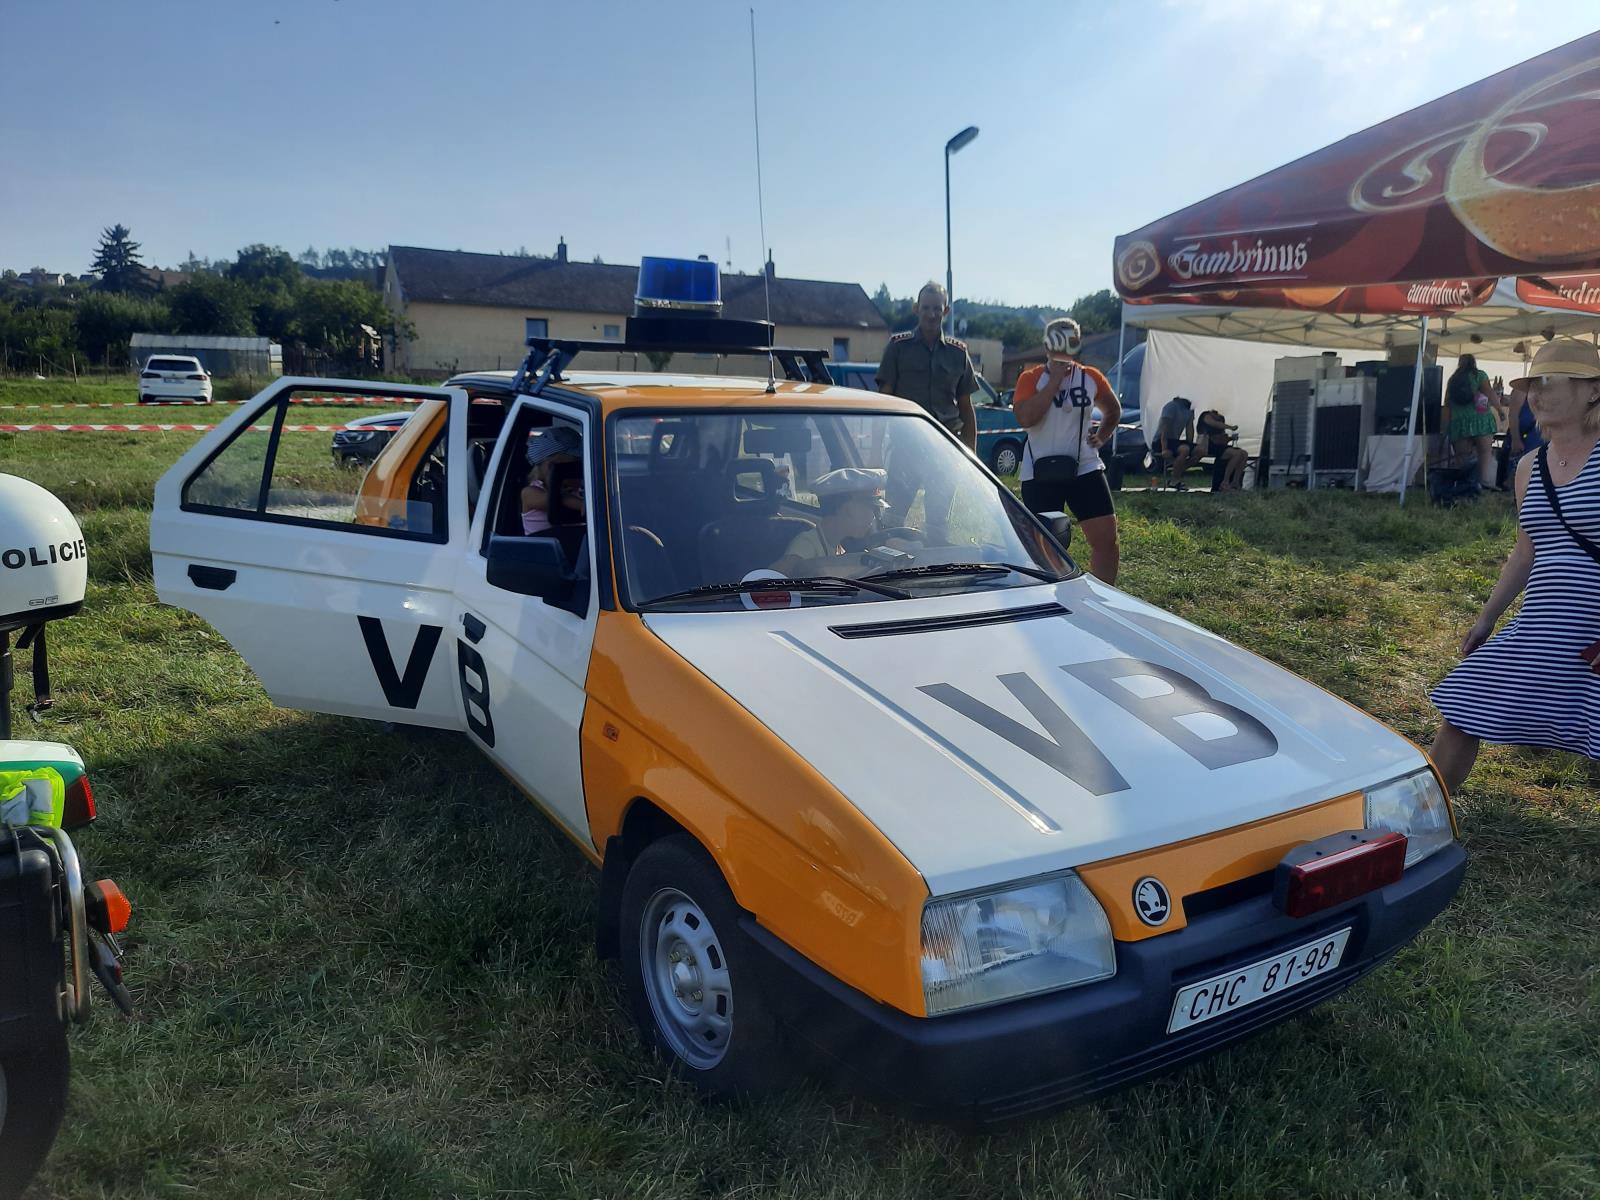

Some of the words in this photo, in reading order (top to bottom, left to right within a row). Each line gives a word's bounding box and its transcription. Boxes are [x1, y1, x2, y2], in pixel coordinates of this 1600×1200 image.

[1167, 239, 1307, 279] Gambrinus
[1053, 387, 1091, 408] VB
[1, 539, 86, 569] OLICIE
[915, 657, 1279, 796] VB
[1189, 975, 1246, 1020] CHC
[1262, 941, 1335, 992] 81-98
